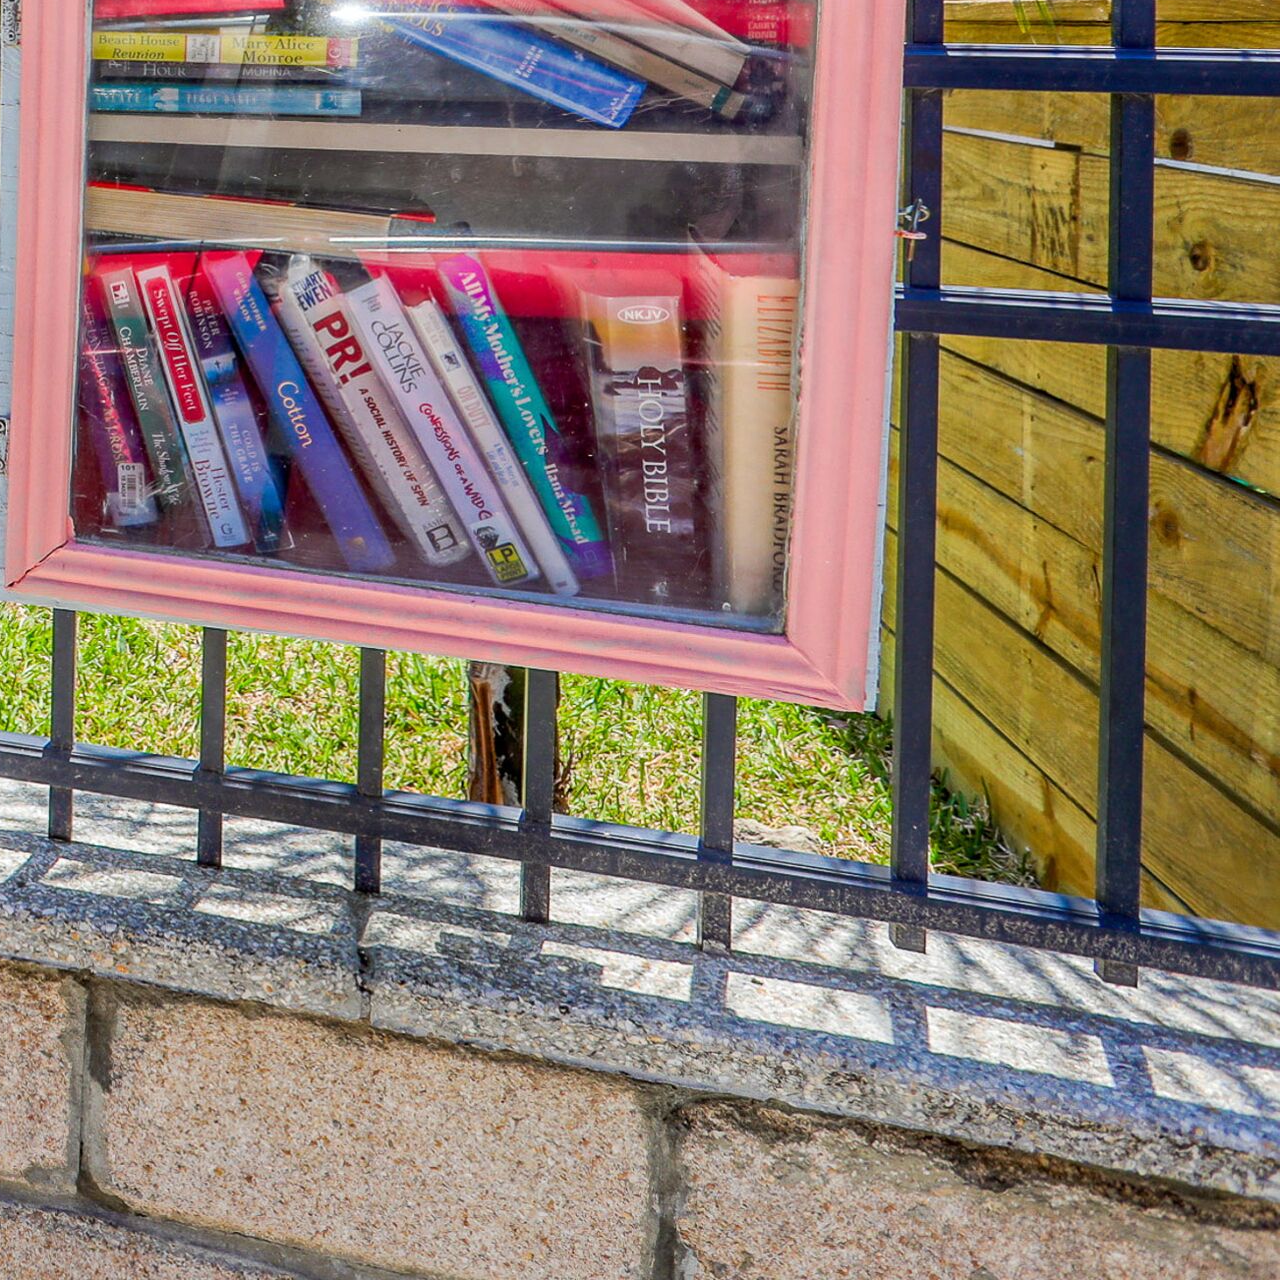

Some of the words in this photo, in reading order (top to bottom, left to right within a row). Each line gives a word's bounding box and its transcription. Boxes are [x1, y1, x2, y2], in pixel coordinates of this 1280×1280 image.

[98, 33, 136, 46] Beach
[139, 35, 180, 47] House
[112, 48, 165, 60] Reunion
[231, 37, 273, 51] Mary
[274, 38, 315, 51] Alice
[242, 50, 304, 64] Monroe
[291, 270, 324, 296] STUART
[296, 282, 333, 312] EWEN
[458, 271, 484, 297] All
[153, 288, 173, 329] Swept
[188, 289, 214, 349] ROBINSON
[202, 299, 221, 336] PETER
[233, 288, 252, 322] WILSON
[470, 295, 492, 322] My
[623, 309, 662, 320] NKJV
[163, 331, 184, 352] Off
[312, 310, 373, 385] PR!
[370, 319, 418, 395] COLLINS
[384, 322, 427, 381] JACKIE
[119, 326, 149, 411] CHAMBERLAIN
[135, 347, 154, 386] DIANE
[172, 354, 188, 380] Her
[482, 322, 526, 398] Mother's
[180, 383, 198, 411] Feet
[358, 387, 369, 396] A
[277, 380, 314, 449] Cotton
[363, 395, 388, 429] SOCIAL
[463, 400, 491, 430] DUTY
[637, 376, 667, 457] HOLY
[151, 431, 165, 449] The
[228, 424, 241, 446] THE
[235, 446, 254, 484] GRAVE
[241, 429, 257, 459] COLD
[250, 462, 262, 473] IS
[381, 429, 410, 468] HISTORY
[418, 402, 461, 462] CONFESSIONS
[454, 463, 465, 477] OF
[463, 482, 485, 510] WILD
[773, 425, 791, 485] SARAH
[156, 449, 174, 485] Shadow
[403, 468, 417, 483] OF
[194, 459, 220, 520] Browne
[211, 466, 231, 511] Hester
[410, 483, 431, 508] SPIN
[641, 459, 672, 535] BIBLE
[559, 498, 590, 545] Masad
[488, 547, 514, 566] LP
